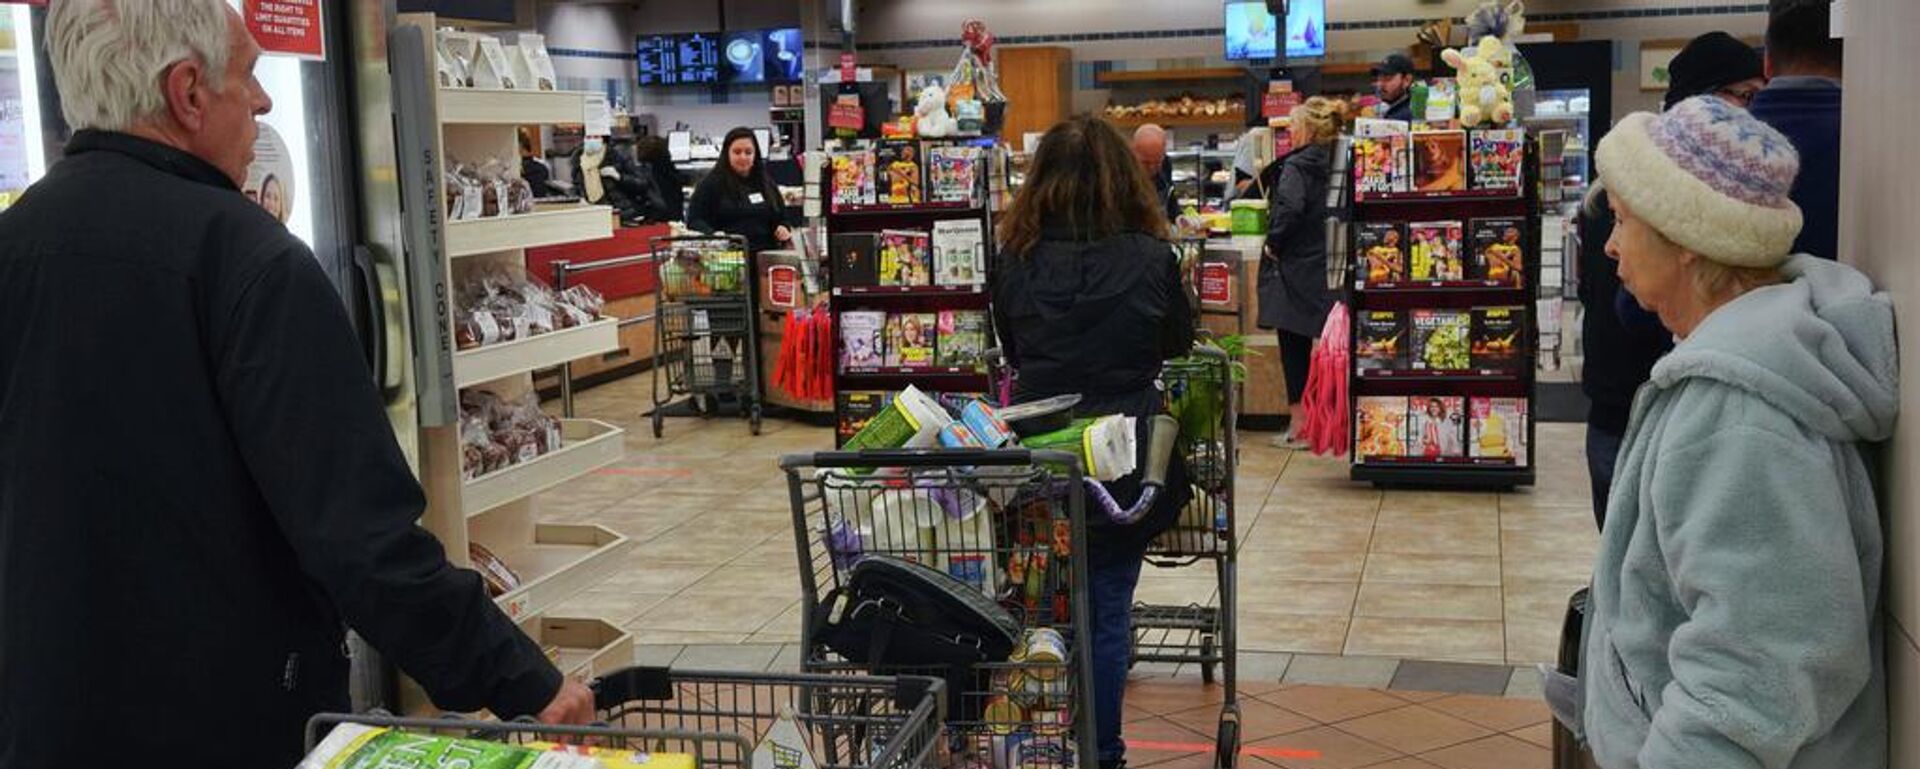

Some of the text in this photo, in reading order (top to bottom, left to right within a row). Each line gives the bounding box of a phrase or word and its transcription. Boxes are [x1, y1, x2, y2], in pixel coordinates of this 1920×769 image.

[260, 2, 304, 15] THE RIGHT TO
[255, 12, 311, 27] LIMIT QUANTITIES
[261, 23, 305, 37] ON ALL ITEMS
[1410, 396, 1461, 412] SHPE
